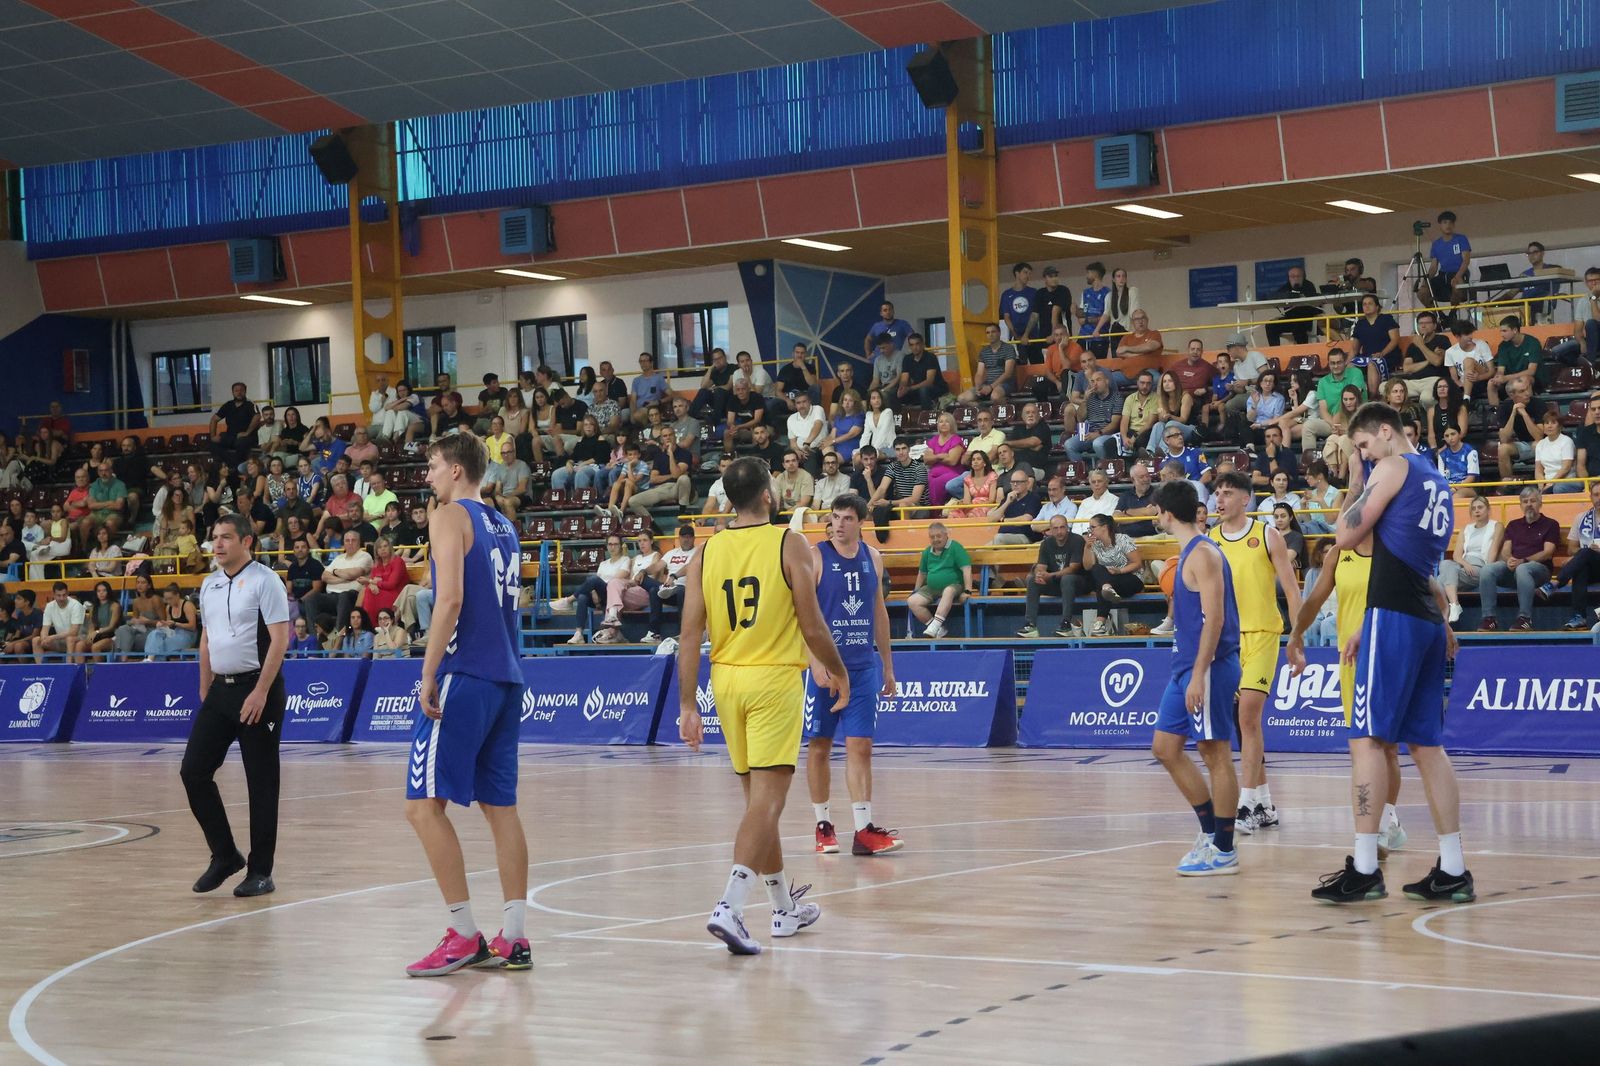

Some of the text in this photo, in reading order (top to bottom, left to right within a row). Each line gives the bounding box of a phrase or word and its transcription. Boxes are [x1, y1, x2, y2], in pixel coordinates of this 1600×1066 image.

[490, 548, 520, 610] 14
[844, 572, 860, 591] 11
[722, 576, 760, 631] 13
[930, 681, 989, 697] RURAL
[1274, 664, 1341, 710] gaz
[1466, 678, 1600, 711] ALIMER
[374, 696, 416, 712] FITECU
[879, 700, 958, 712] DE ZAMORA
[534, 710, 556, 722] Chef
[602, 709, 625, 721] Chef
[1069, 712, 1158, 726] MORALEJO
[1267, 716, 1314, 726] Ganaderos
[1317, 717, 1328, 726] de
